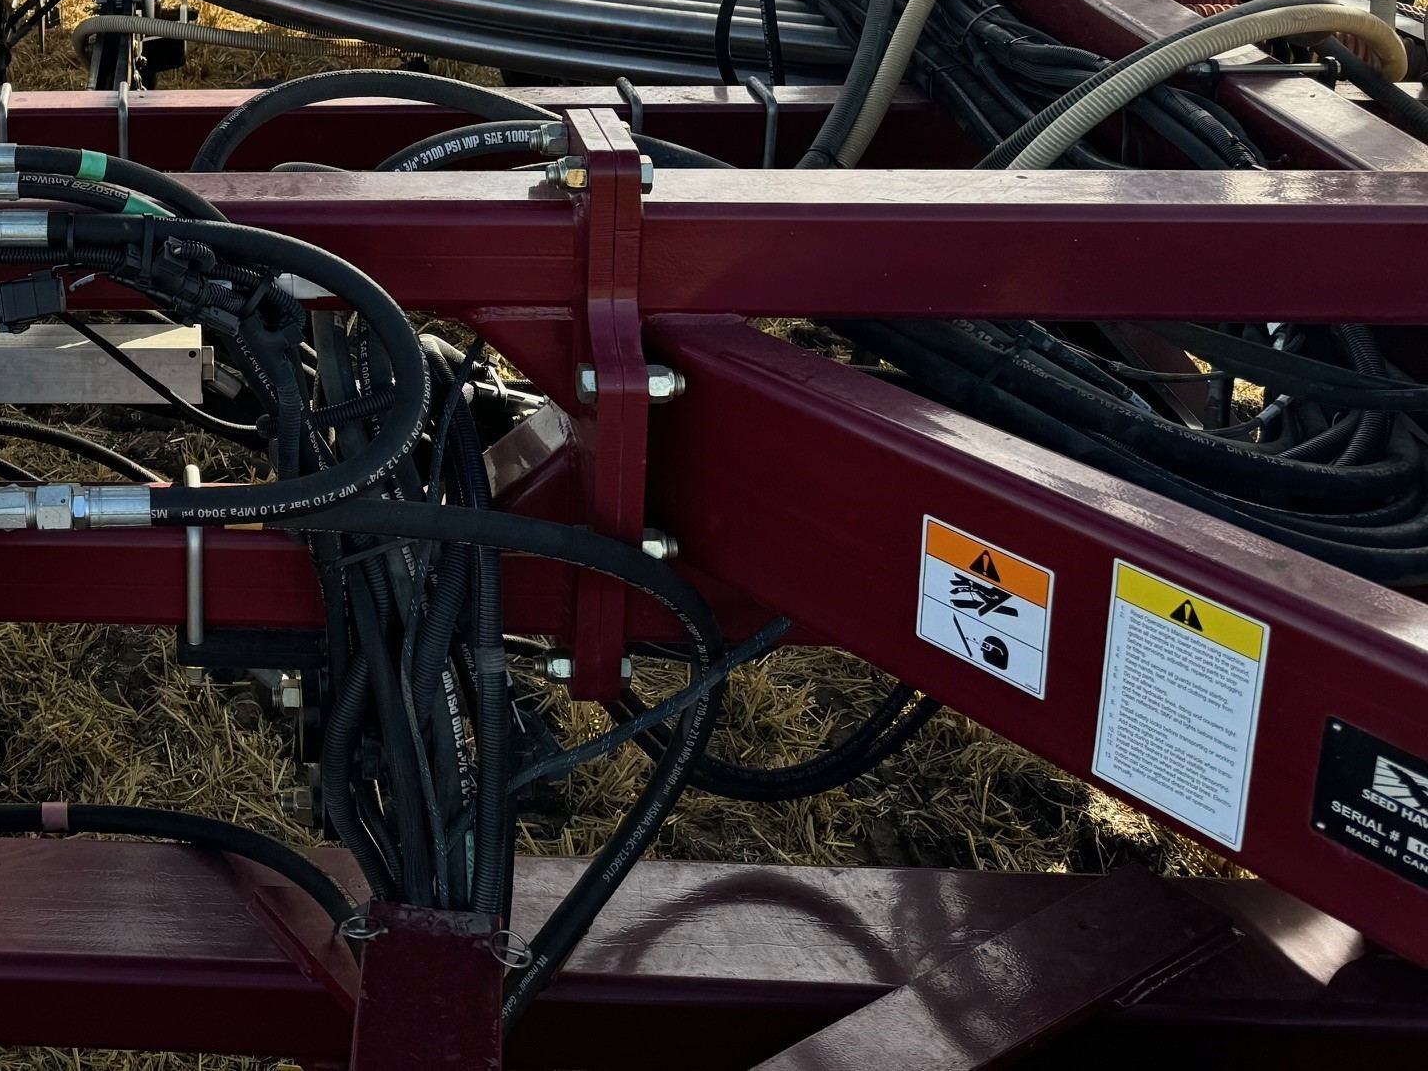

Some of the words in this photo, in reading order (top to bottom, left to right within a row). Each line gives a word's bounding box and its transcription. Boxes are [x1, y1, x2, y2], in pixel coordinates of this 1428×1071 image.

[420, 146, 445, 164] 3100
[444, 140, 462, 154] PSI
[462, 135, 480, 149] WP
[483, 131, 504, 145] SAE
[411, 420, 423, 438] DN
[402, 442, 413, 455] 19
[366, 469, 386, 486] 3/4"
[313, 492, 337, 507] 210
[338, 483, 358, 499] WP
[198, 508, 227, 518] 3040
[230, 506, 257, 517] MPa
[260, 503, 286, 516] 21.0
[290, 499, 310, 510] bar
[181, 510, 194, 518] psi
[442, 670, 453, 694] WP
[446, 692, 458, 712] PSI
[451, 714, 465, 748] 3100
[1362, 788, 1398, 814] SEED
[640, 801, 662, 826] MSHA
[1331, 800, 1386, 837] SERIAL
[1389, 830, 1402, 842] #
[1345, 825, 1380, 848] MADE
[1384, 845, 1398, 858] IN
